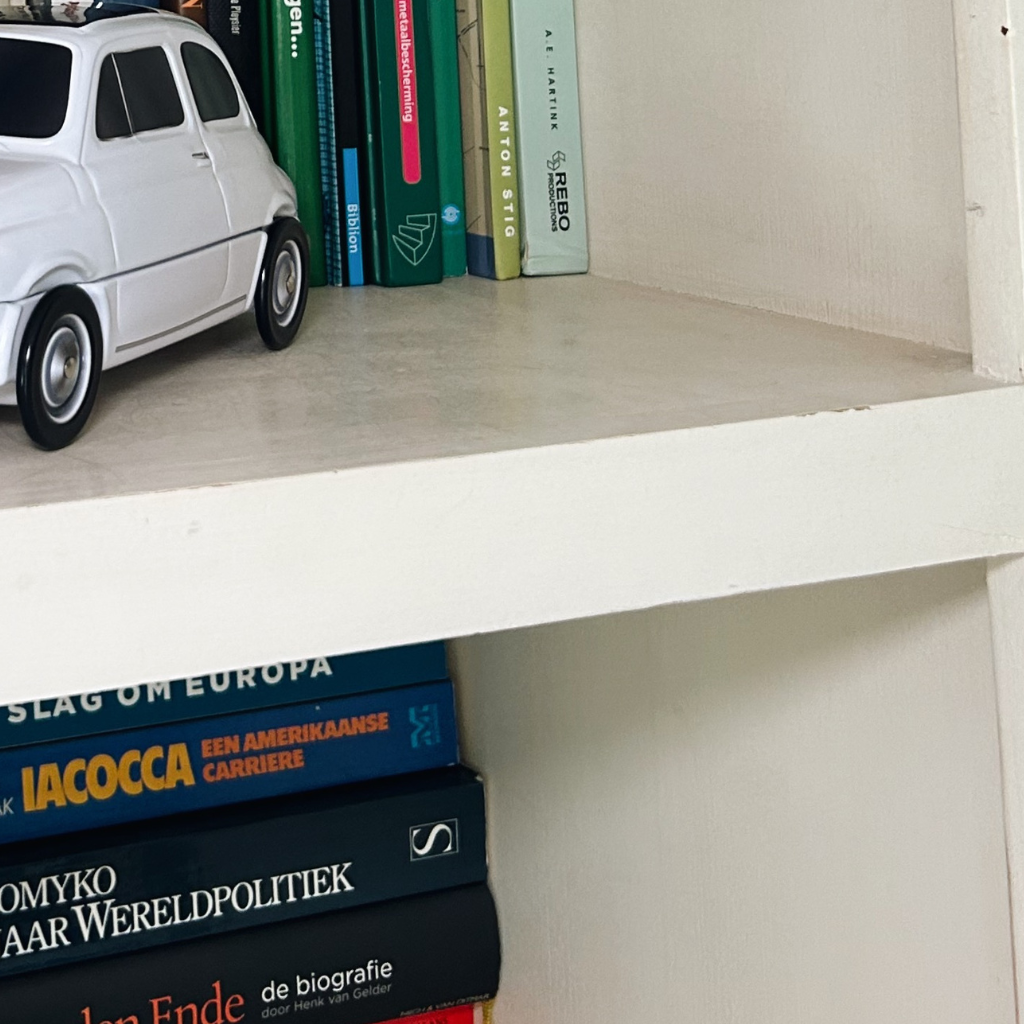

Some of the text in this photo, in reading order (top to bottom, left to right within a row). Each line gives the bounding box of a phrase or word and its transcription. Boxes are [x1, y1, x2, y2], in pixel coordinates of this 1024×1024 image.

[398, 0, 415, 123] metaalbescherming
[547, 67, 558, 131] HARTINK
[498, 106, 516, 238] ANTON STIG
[547, 172, 558, 233] PRODUCTIONS
[555, 171, 571, 233] REBO
[347, 203, 358, 253] Biblion
[7, 692, 103, 724] SLAG
[116, 679, 172, 707] OM
[184, 656, 333, 698] EUROPA
[201, 711, 390, 758] EEN AMERIKAANSE
[202, 748, 305, 782] CARRIERE
[21, 741, 196, 813] IACOCCA
[71, 861, 355, 942] WERELDPOLITIEK
[148, 980, 246, 1024] Ende
[260, 958, 394, 1003] de biografie
[260, 982, 393, 1019] door Henk van Gelder
